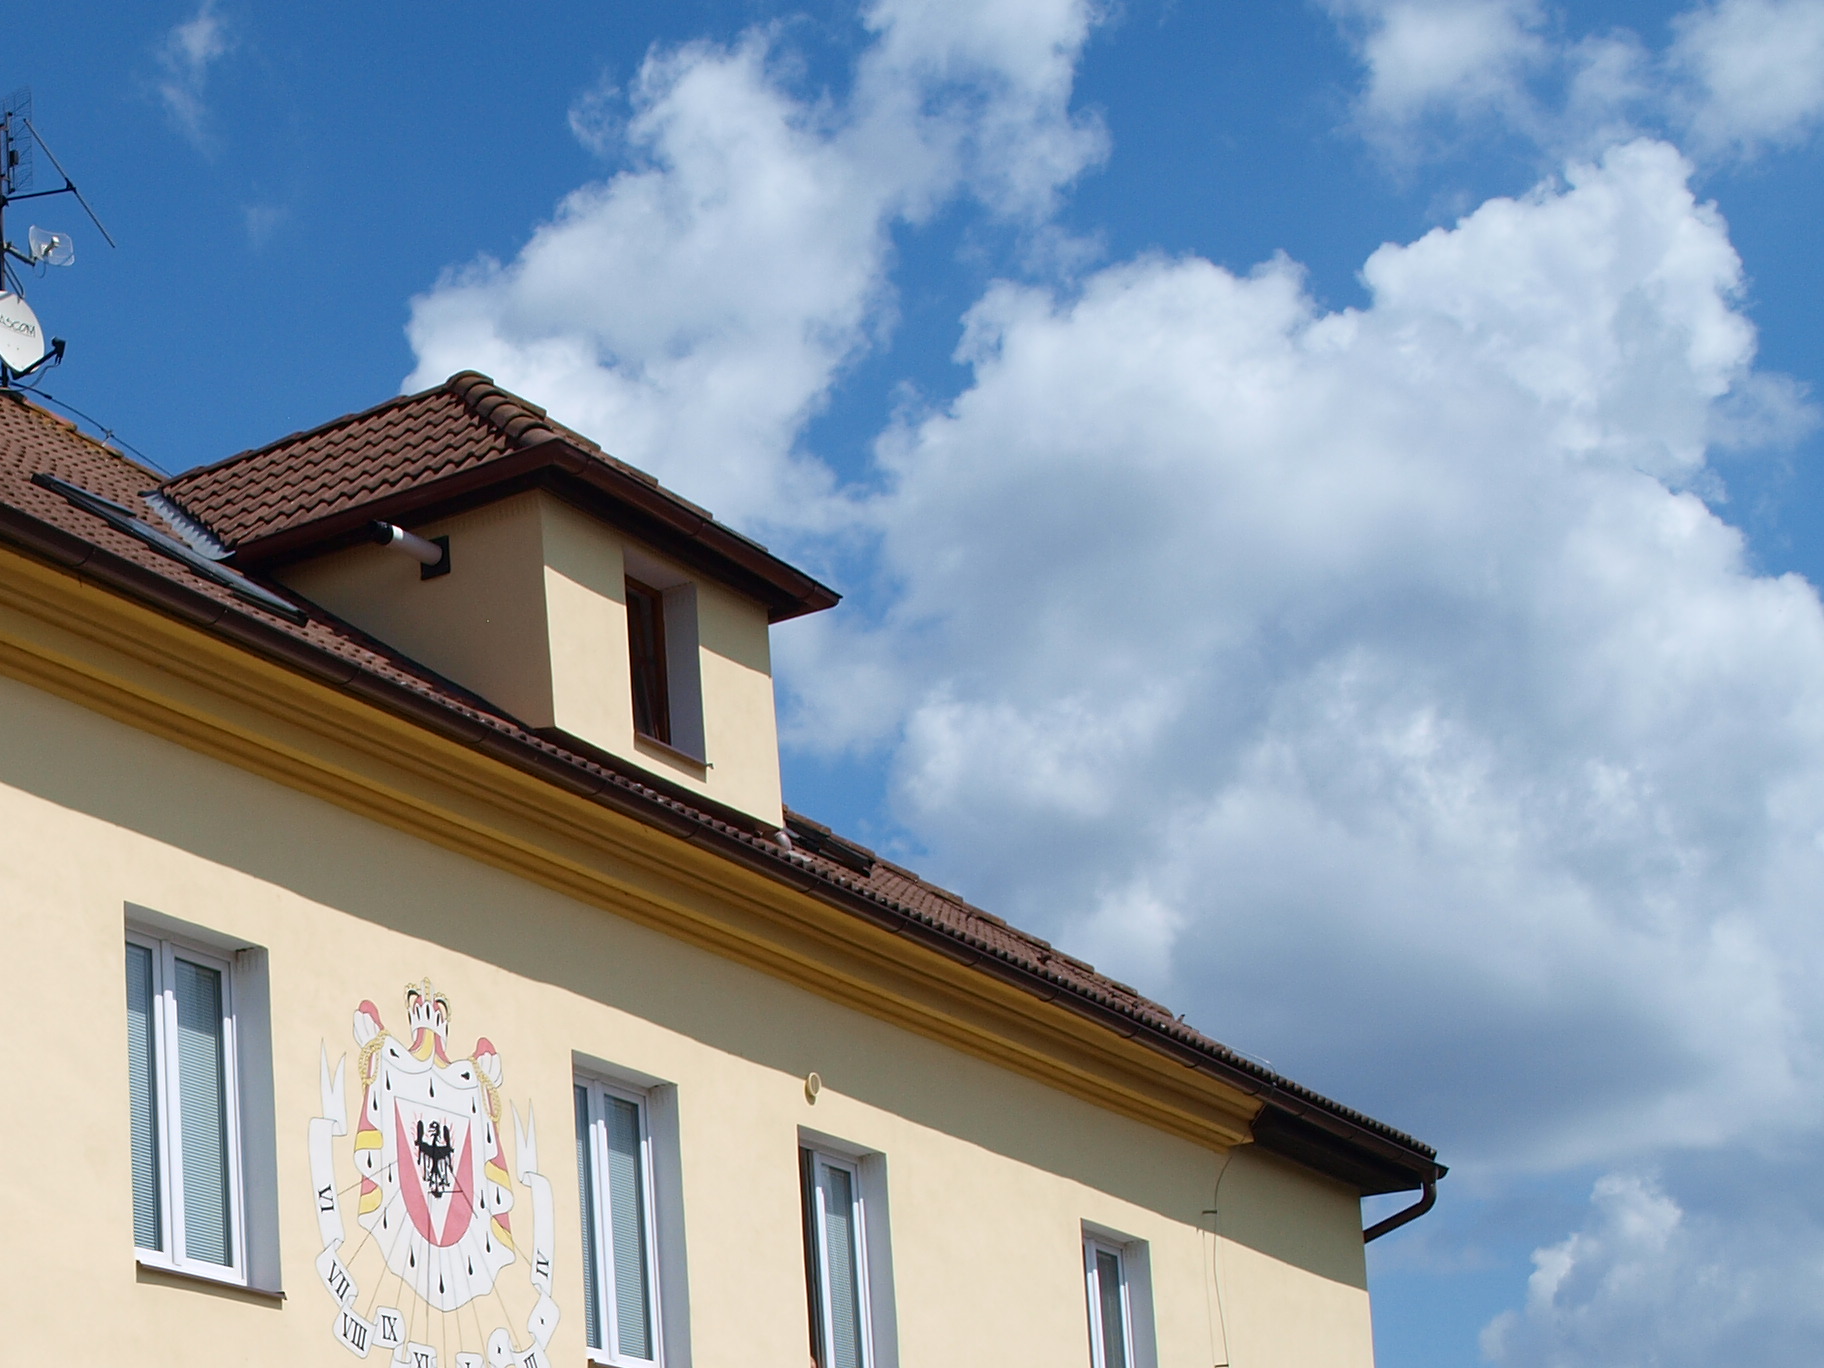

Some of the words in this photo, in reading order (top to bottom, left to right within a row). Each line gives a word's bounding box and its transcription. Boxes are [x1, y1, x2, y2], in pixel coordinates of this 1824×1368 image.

[327, 1260, 350, 1301] VII
[342, 1312, 367, 1351] VIII
[381, 1314, 398, 1343] IX
